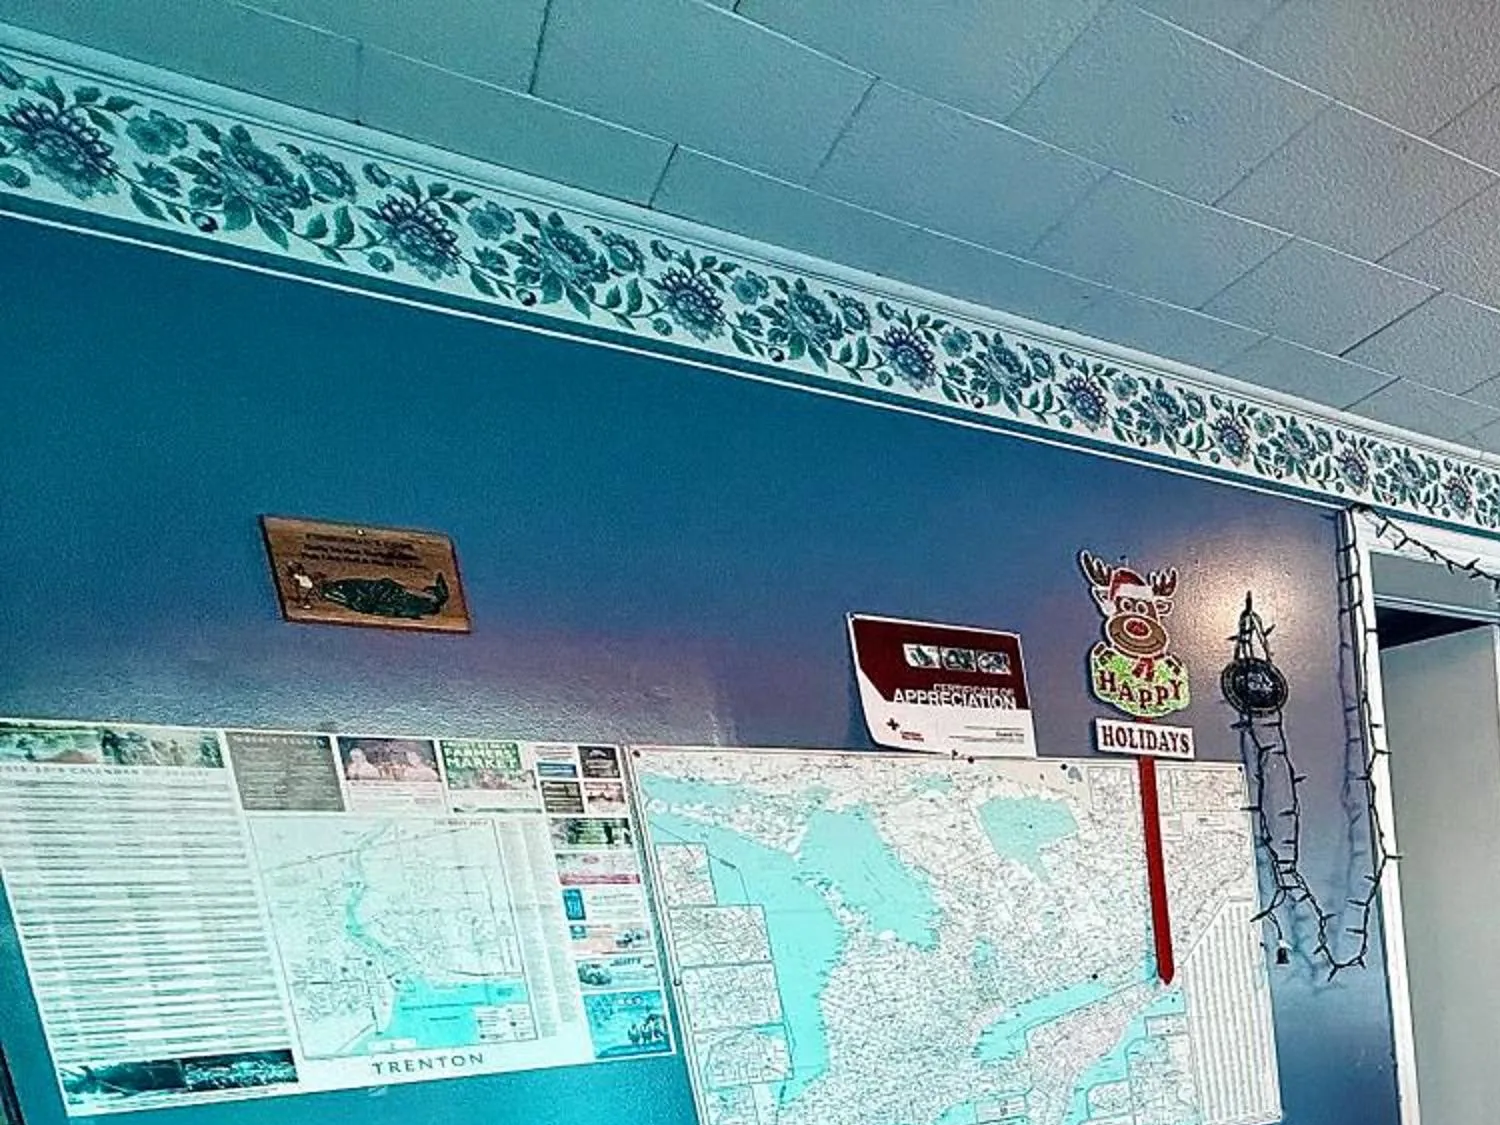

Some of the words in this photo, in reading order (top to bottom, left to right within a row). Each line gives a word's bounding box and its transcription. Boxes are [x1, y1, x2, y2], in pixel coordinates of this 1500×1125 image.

[893, 688, 1018, 710] APPRECIATION
[1098, 669, 1183, 710] HAPPY
[1102, 725, 1191, 754] HOLIDAYS
[446, 757, 518, 770] MARKET
[371, 1052, 484, 1076] TRENTON
